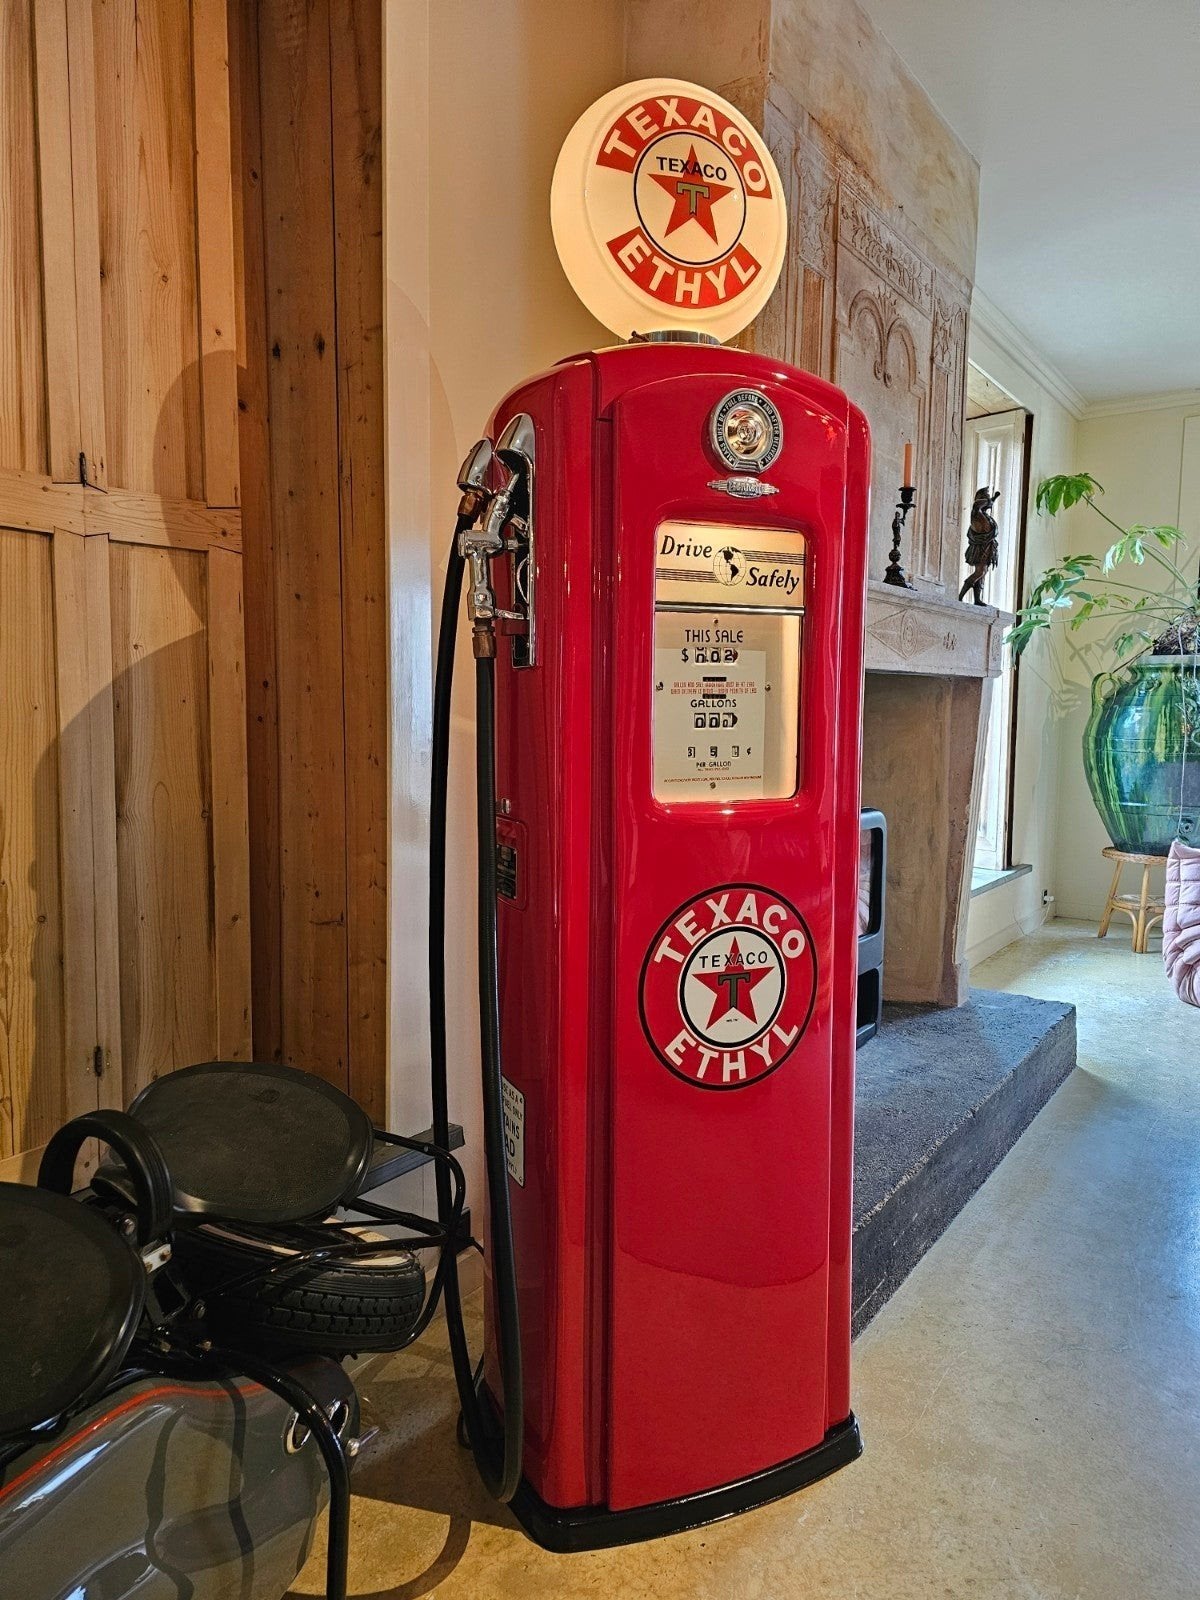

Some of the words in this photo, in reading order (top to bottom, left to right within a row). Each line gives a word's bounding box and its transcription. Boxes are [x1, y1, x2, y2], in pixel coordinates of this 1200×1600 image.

[604, 98, 767, 192] TEXACO
[656, 156, 727, 181] TEXACO
[677, 181, 710, 216] T
[617, 235, 756, 305] ETHYL
[725, 398, 738, 410] FULL
[737, 394, 759, 403] BEFORE
[660, 535, 713, 558] Drive
[746, 567, 800, 595] Safely
[684, 629, 710, 643] THIS
[715, 629, 744, 643] SALE
[681, 648, 689, 663] $
[690, 699, 737, 708] GALLONS
[653, 893, 805, 964] TEXACO
[699, 951, 768, 968] TEXACO
[718, 972, 750, 1009] T
[664, 1024, 799, 1083] ETHYL
[504, 1115, 520, 1140] AINS
